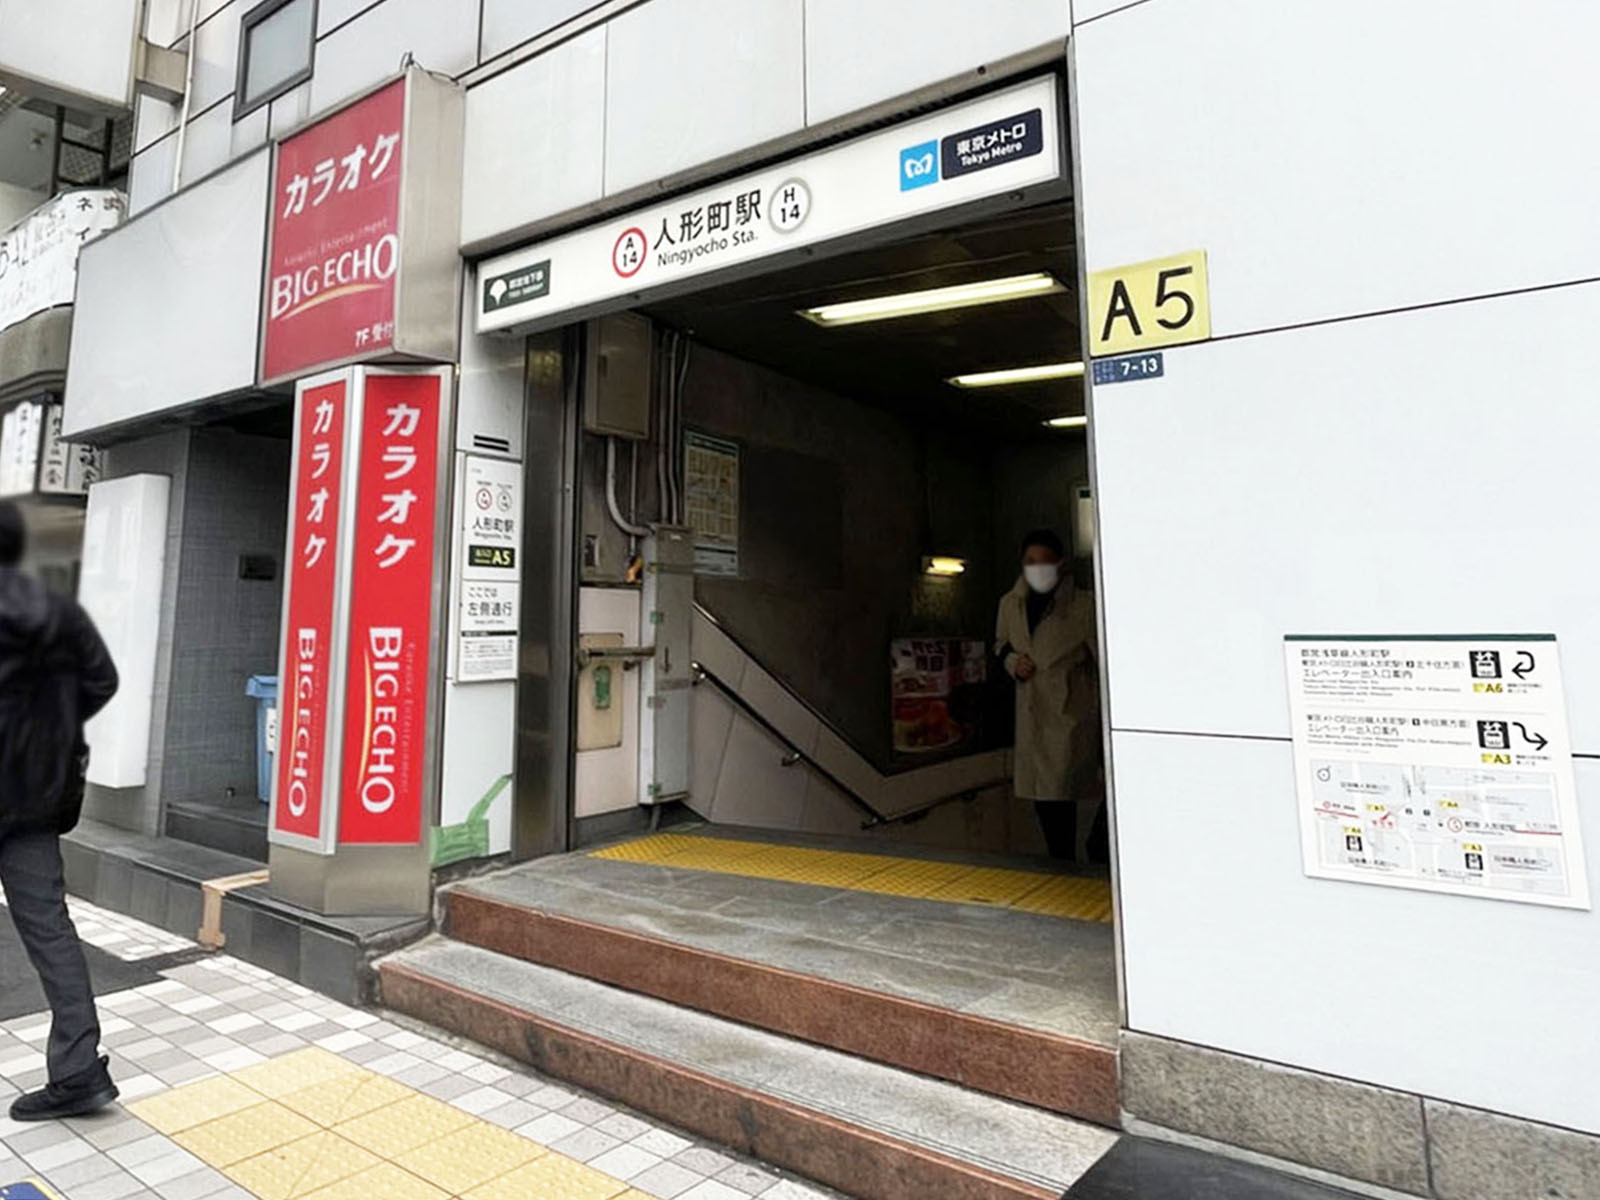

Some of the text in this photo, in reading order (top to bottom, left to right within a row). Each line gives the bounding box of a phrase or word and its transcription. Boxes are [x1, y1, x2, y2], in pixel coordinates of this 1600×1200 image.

[956, 122, 1027, 156] 東京メトロ
[961, 141, 1022, 166] Tokyo Metro
[282, 132, 399, 219] カラオケ
[784, 187, 795, 203] H
[653, 189, 761, 250] 人形町駅
[781, 204, 800, 223] 14
[622, 252, 638, 268] 14
[624, 236, 635, 250] A
[657, 230, 758, 266] Ningyocho Sta.
[271, 265, 319, 320] BIG
[323, 233, 398, 288] ECHO
[1101, 266, 1194, 341] A5
[355, 328, 369, 347] 7F
[1120, 358, 1158, 376] 7-13
[305, 400, 334, 569] カラオケ
[374, 403, 421, 568] カラオケ
[492, 549, 511, 566] A5
[298, 628, 317, 699] BIG
[361, 627, 403, 813] BIG ECHO
[288, 709, 311, 817] ECHO
